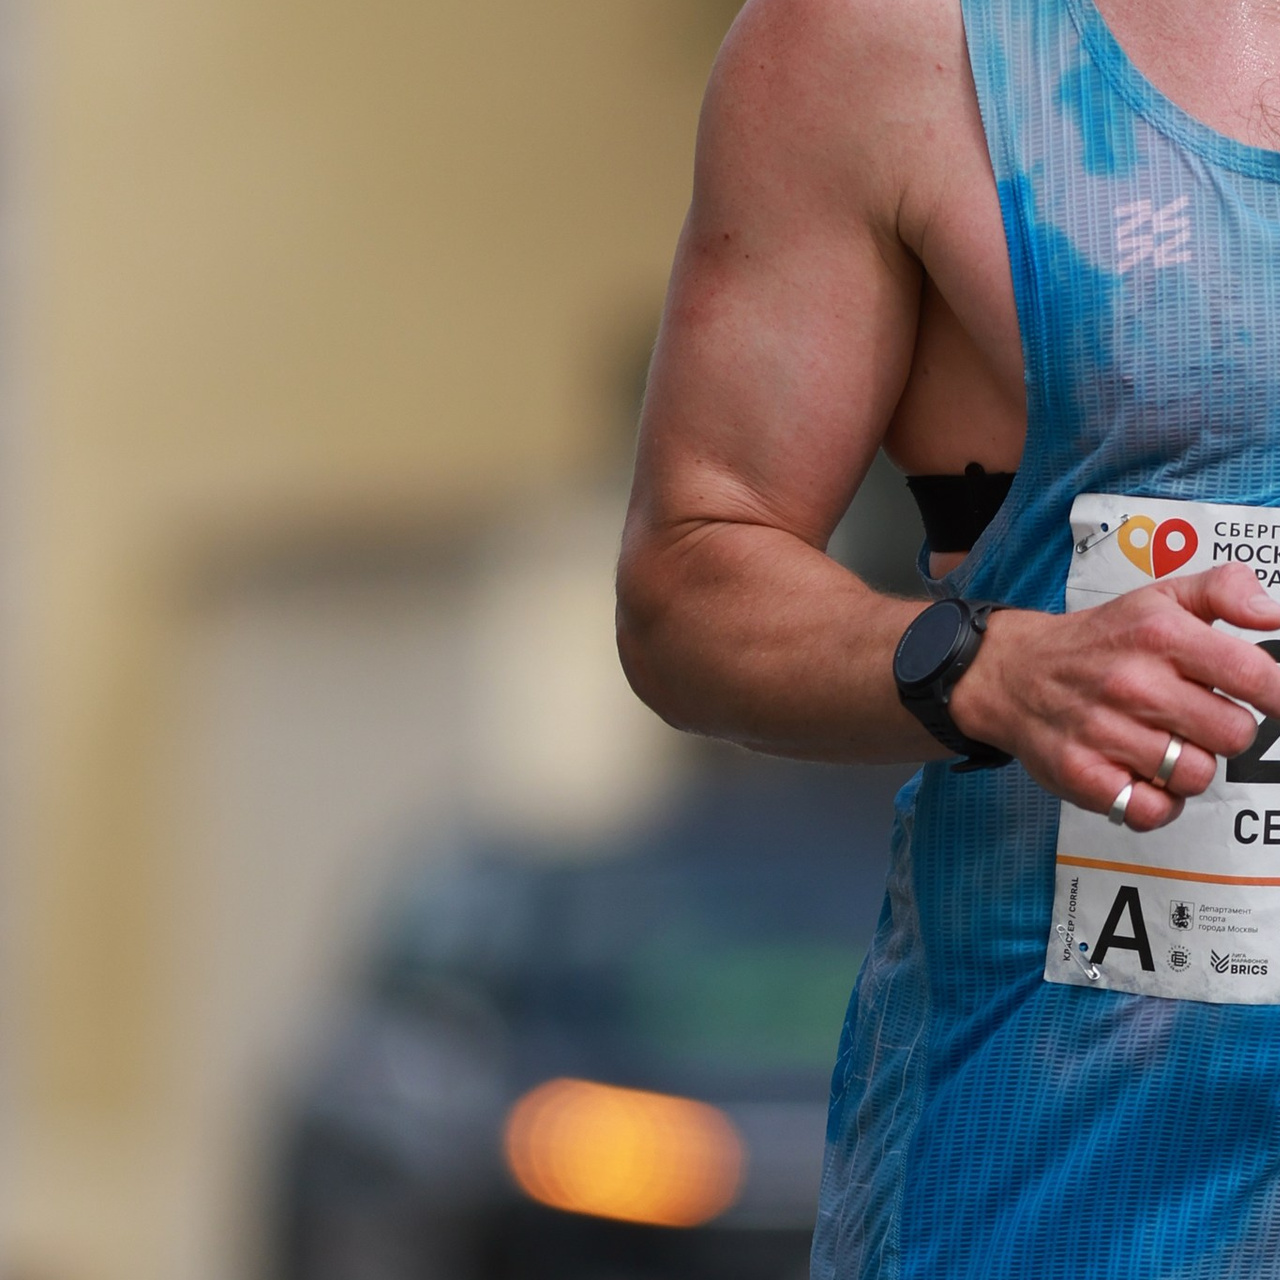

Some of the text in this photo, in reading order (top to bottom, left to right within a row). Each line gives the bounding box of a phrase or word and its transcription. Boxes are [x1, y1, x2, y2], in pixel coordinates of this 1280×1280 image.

[1069, 877, 1079, 912] CORRAL
[1199, 905, 1252, 914] Департамент
[1199, 915, 1226, 923] спорта
[1198, 924, 1258, 933] города Москвы
[1231, 964, 1268, 975] BRICS
